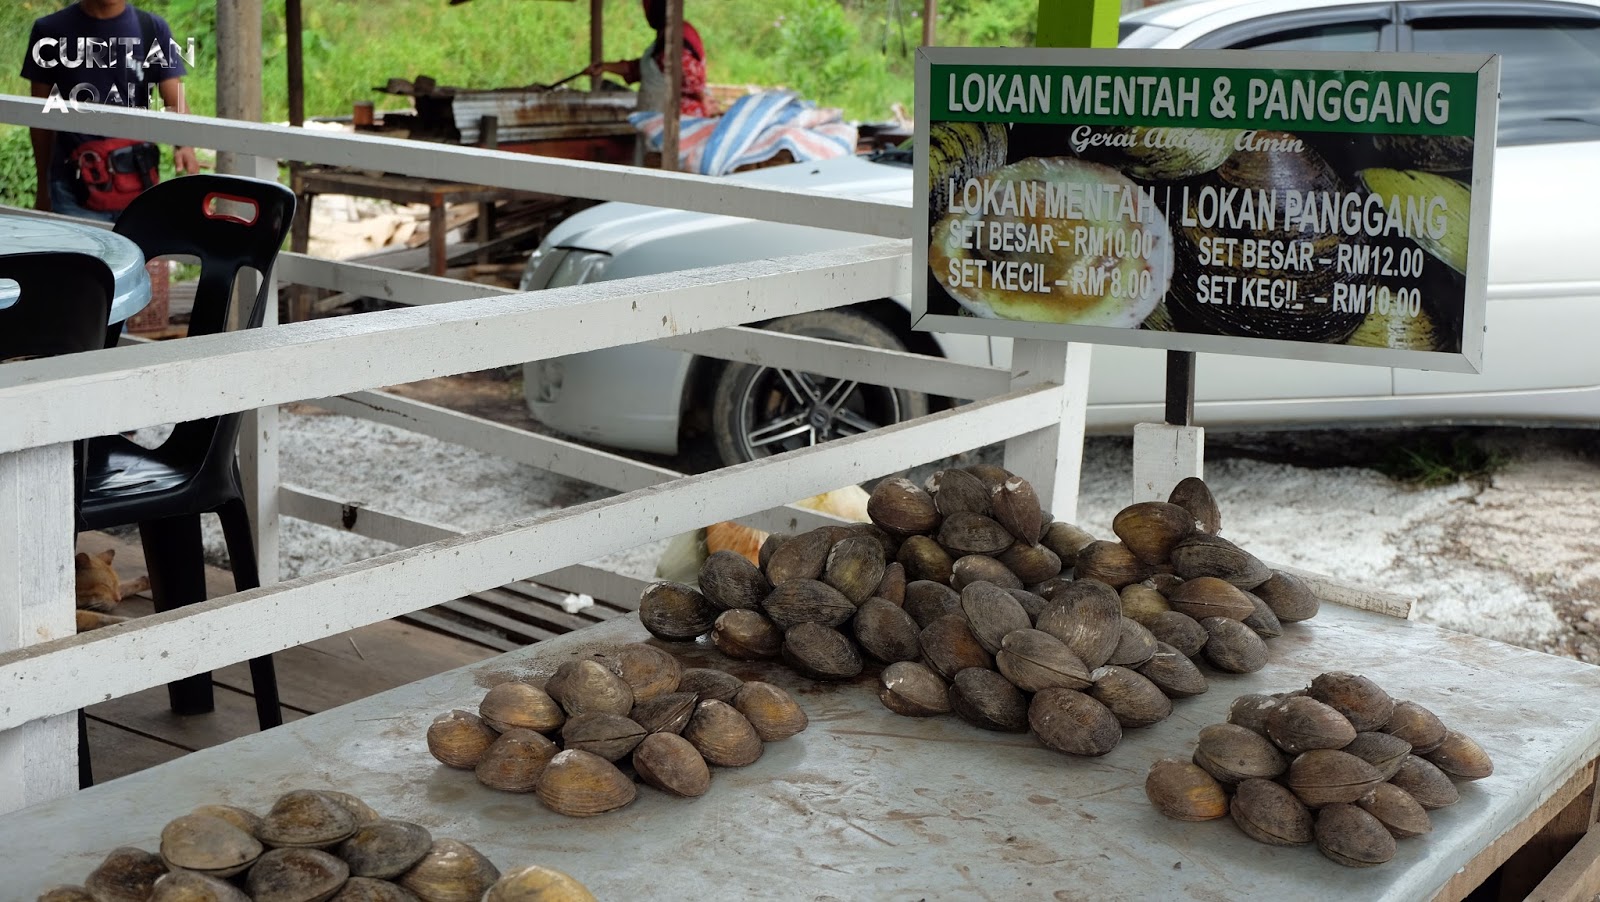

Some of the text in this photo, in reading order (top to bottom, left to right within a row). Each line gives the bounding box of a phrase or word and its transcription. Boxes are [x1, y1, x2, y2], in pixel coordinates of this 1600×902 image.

[948, 73, 1450, 125] LOKAN MENTAH & PANGGANG
[1070, 125, 1138, 152] Gerai
[1233, 130, 1305, 153] Amin
[949, 178, 1155, 224] LOKAN MENTAH
[1181, 186, 1448, 240] LOKAN PANGGANG
[949, 219, 985, 249] SET
[989, 222, 1054, 254] BESAR
[1074, 226, 1153, 260] RM10.00
[1198, 236, 1238, 267] SET
[1242, 239, 1314, 271] BESAR
[1337, 244, 1424, 278] RM12.00
[948, 257, 987, 288] SET
[992, 260, 1050, 293] KECIL
[1196, 274, 1237, 305] SET
[1240, 277, 1304, 310] KECIL
[1332, 282, 1421, 317] RM10.00
